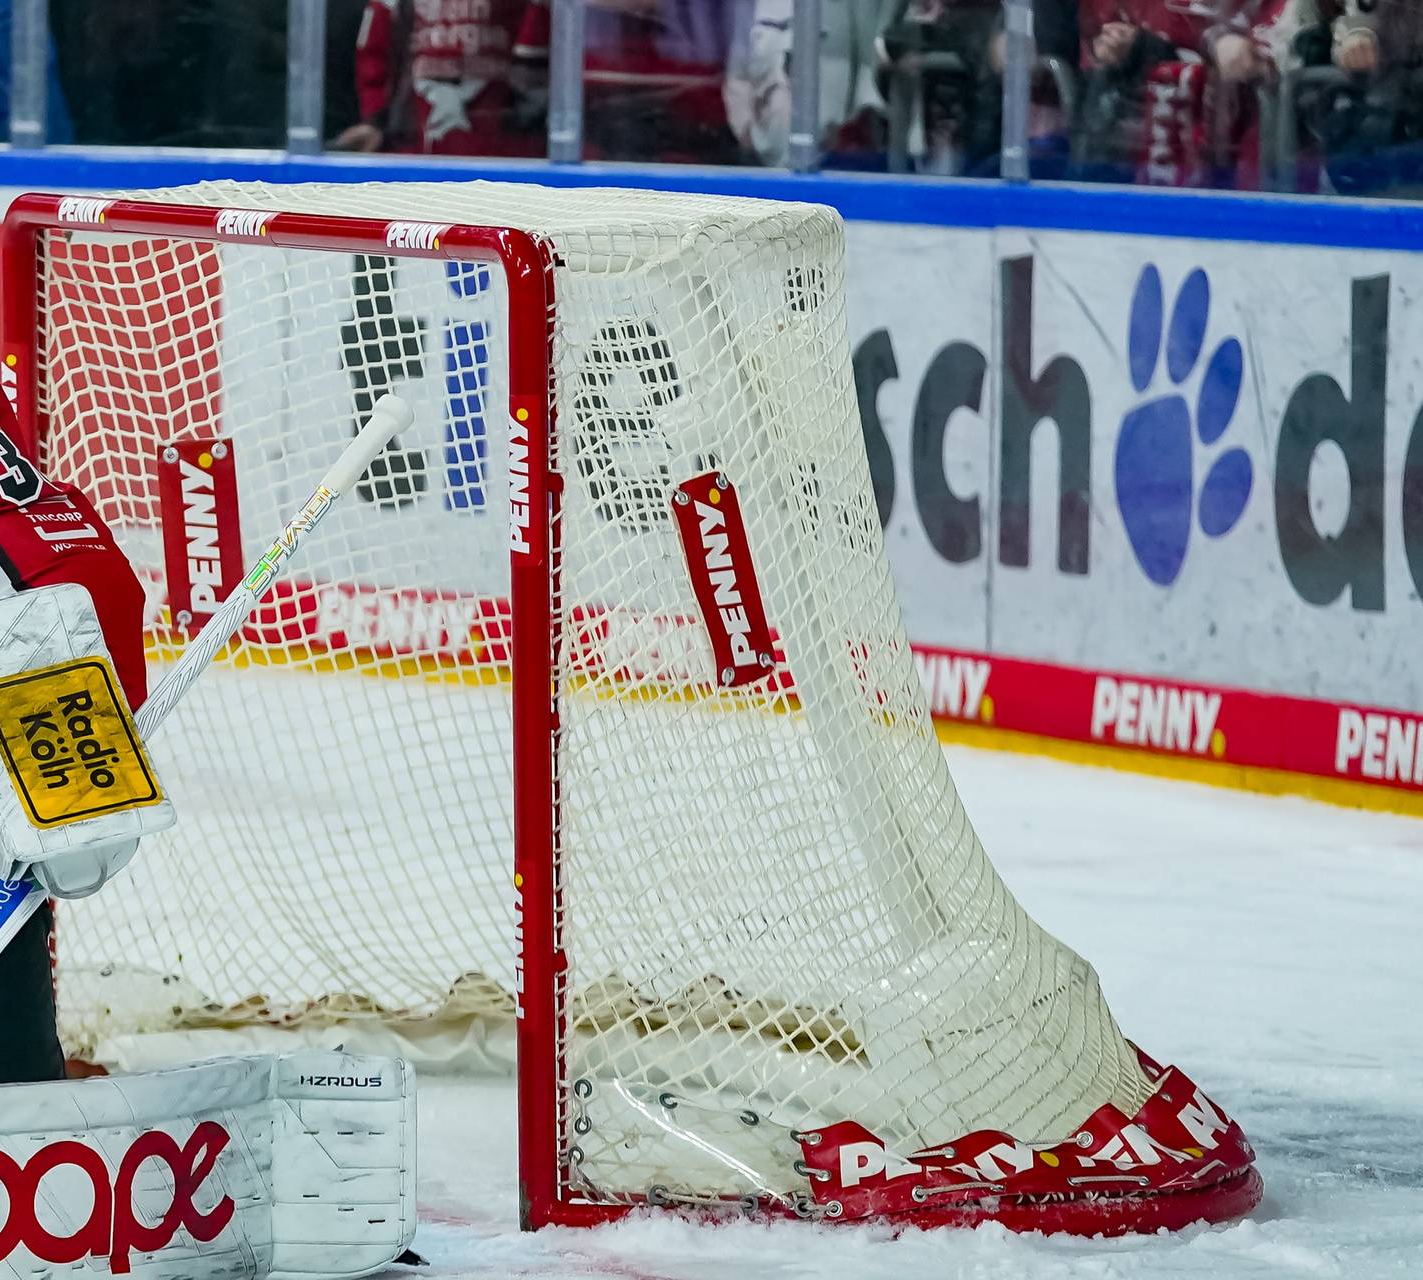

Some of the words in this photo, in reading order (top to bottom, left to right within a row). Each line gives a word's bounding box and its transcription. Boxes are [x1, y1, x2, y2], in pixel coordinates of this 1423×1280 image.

[19, 711, 75, 790] Köln
[57, 689, 120, 789] Radio
[1335, 707, 1423, 785] PEN
